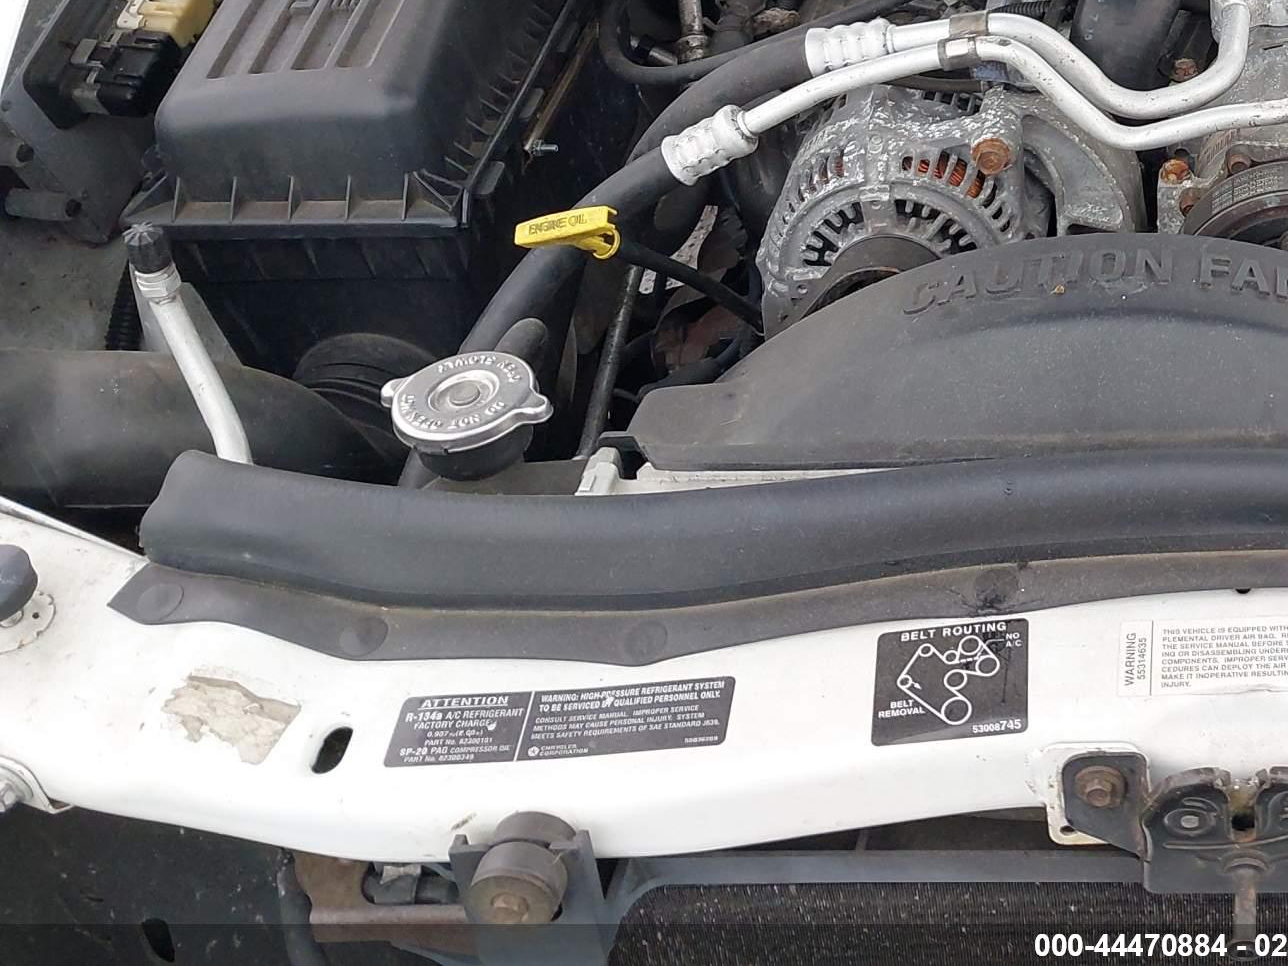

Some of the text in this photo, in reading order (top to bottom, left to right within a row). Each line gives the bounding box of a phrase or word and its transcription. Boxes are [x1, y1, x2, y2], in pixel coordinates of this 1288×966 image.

[528, 214, 587, 235] ENGINE OIL
[902, 248, 1175, 315] CAUTION
[901, 622, 1007, 642] BELT ROUTING
[1125, 633, 1136, 686] WARNING
[1137, 637, 1147, 680] 55314635
[1192, 648, 1257, 656] DISASSEMBLING
[542, 694, 578, 702] WARNING:
[641, 683, 693, 695] REFRIGERANT
[695, 681, 725, 690] SYSTEM
[422, 696, 509, 708] ATTENTION
[539, 704, 550, 712] TO
[564, 701, 600, 711] SERVICED
[614, 696, 652, 707] QUALIFIED
[654, 693, 698, 704] PERSONNEL
[701, 690, 721, 699] ONLY.
[890, 700, 914, 708] BELT
[405, 711, 443, 722] R-134a
[463, 708, 524, 718] REFRIGERANT
[569, 713, 596, 721] SERVICE
[599, 711, 628, 719] MANUAL.
[633, 707, 669, 716] IMPROPER
[671, 705, 699, 713] SERVICE
[878, 707, 925, 718] REMOVAL
[414, 721, 453, 729] FACTORY
[533, 712, 705, 731] METHODS MAY CAUSE PERSONAL INJURY. SYSTEM
[556, 729, 582, 738] SAFETY
[584, 725, 636, 736] REQUIREMENTS
[664, 720, 701, 729] STANDARD
[973, 719, 1021, 733] 53008745
[400, 748, 428, 756] SP-20
[539, 748, 589, 756] CORPORATION
